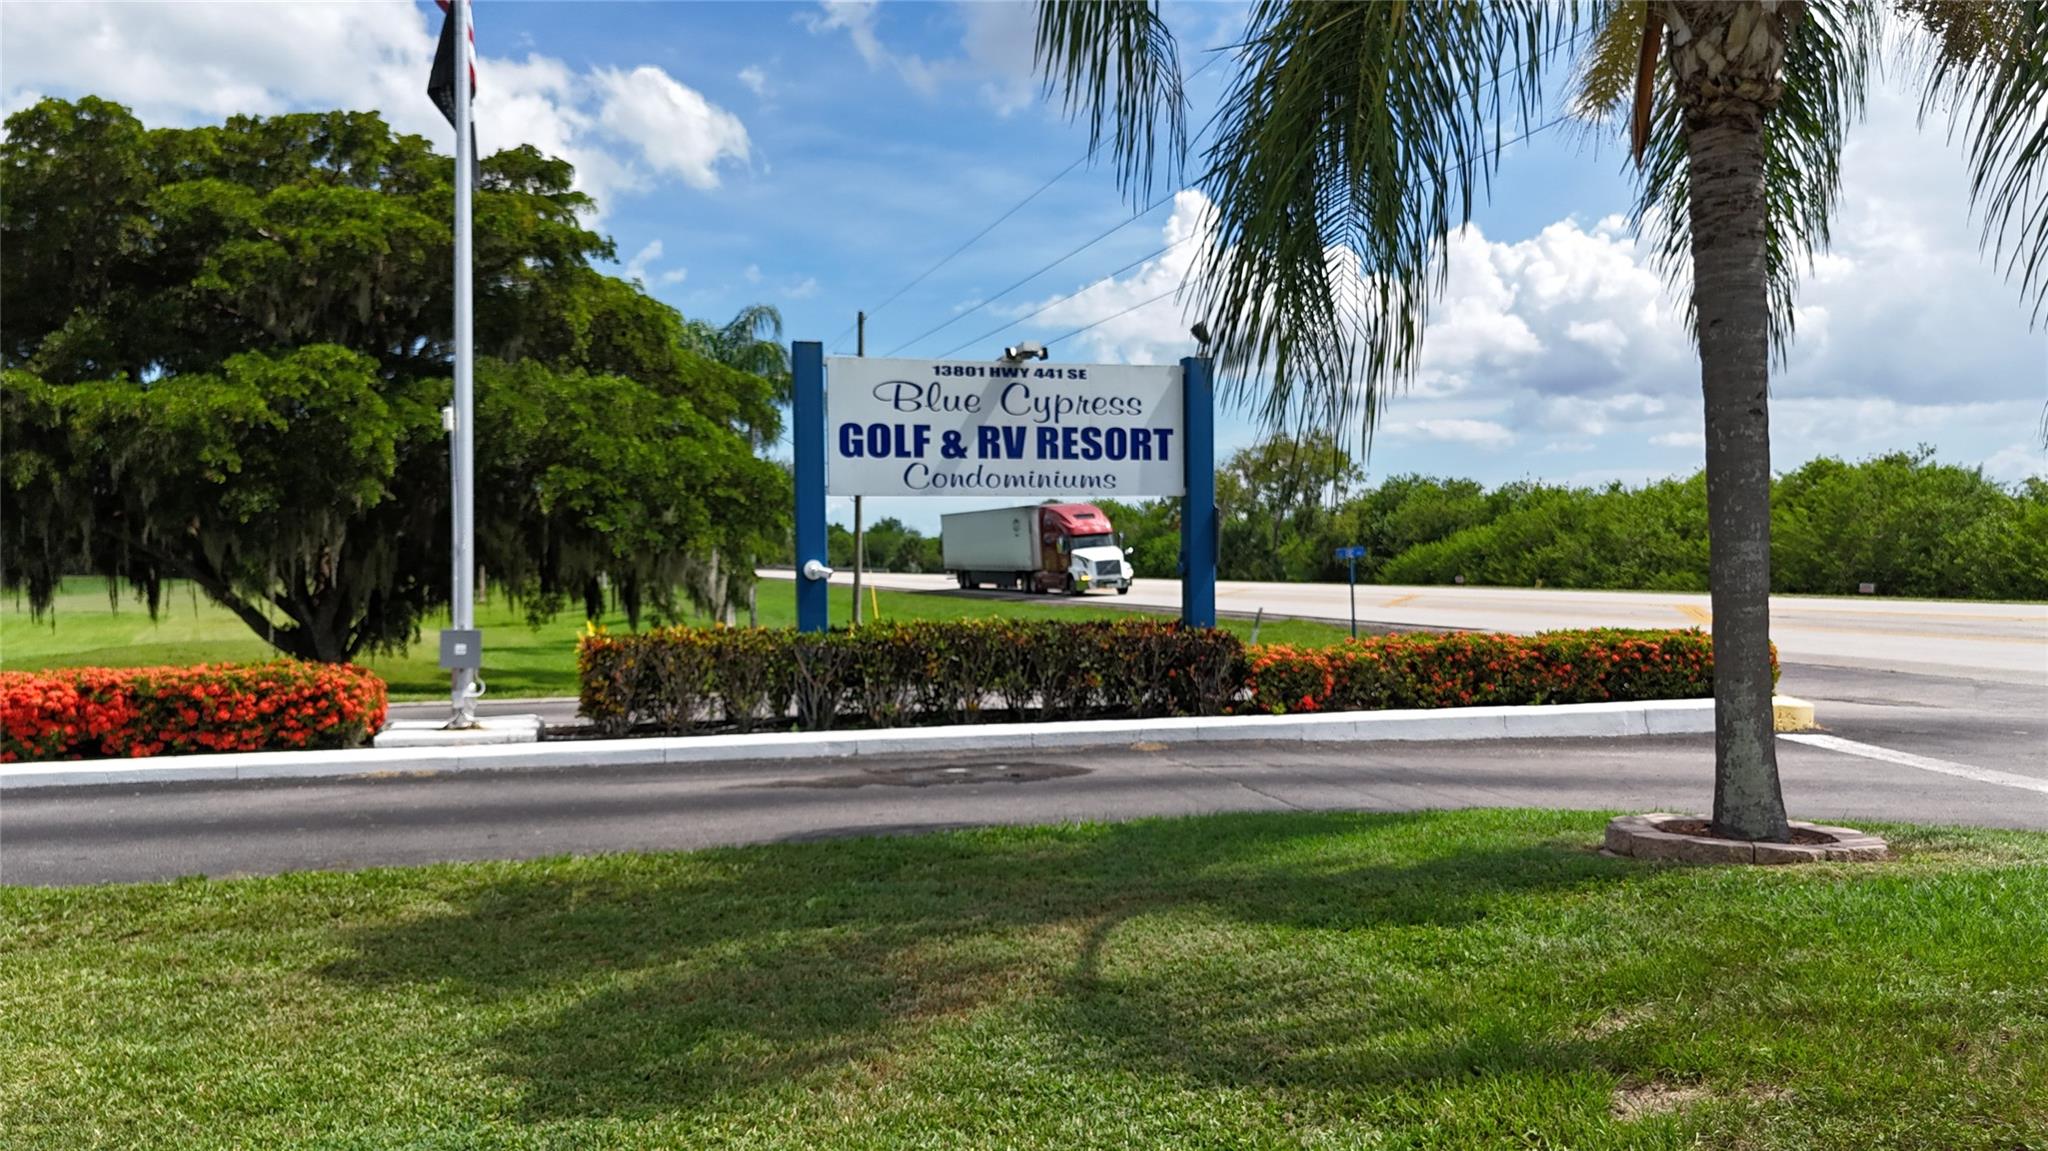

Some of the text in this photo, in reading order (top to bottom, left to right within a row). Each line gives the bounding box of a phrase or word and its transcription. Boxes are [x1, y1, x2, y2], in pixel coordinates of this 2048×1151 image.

[932, 365, 1088, 380] 13801 HWY 441 SE
[872, 380, 1142, 424] Blue Cypress
[838, 422, 1174, 461] GOLF & RV RESORT
[903, 462, 1117, 490] Condominiums
